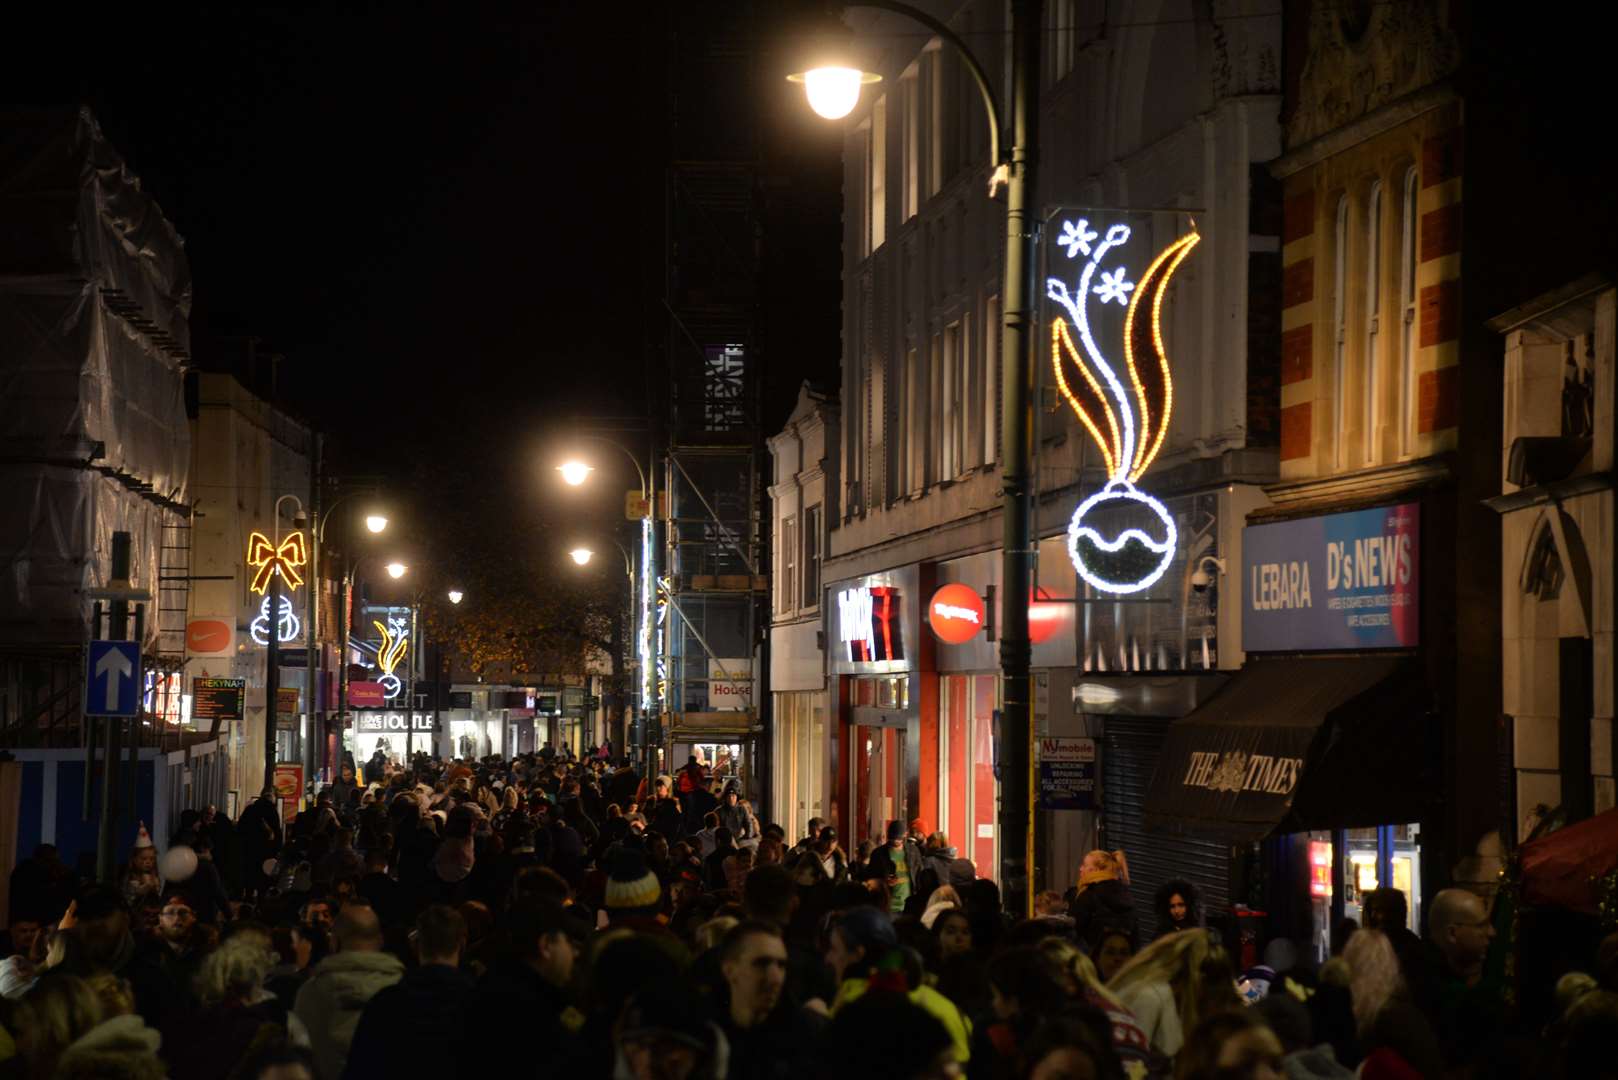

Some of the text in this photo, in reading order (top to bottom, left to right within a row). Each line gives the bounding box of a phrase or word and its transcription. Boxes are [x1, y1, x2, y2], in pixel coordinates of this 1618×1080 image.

[1327, 534, 1412, 591] D's NEWS
[1252, 561, 1312, 610] LEBARA
[714, 684, 752, 695] House
[1183, 752, 1303, 794] THE TIMES
